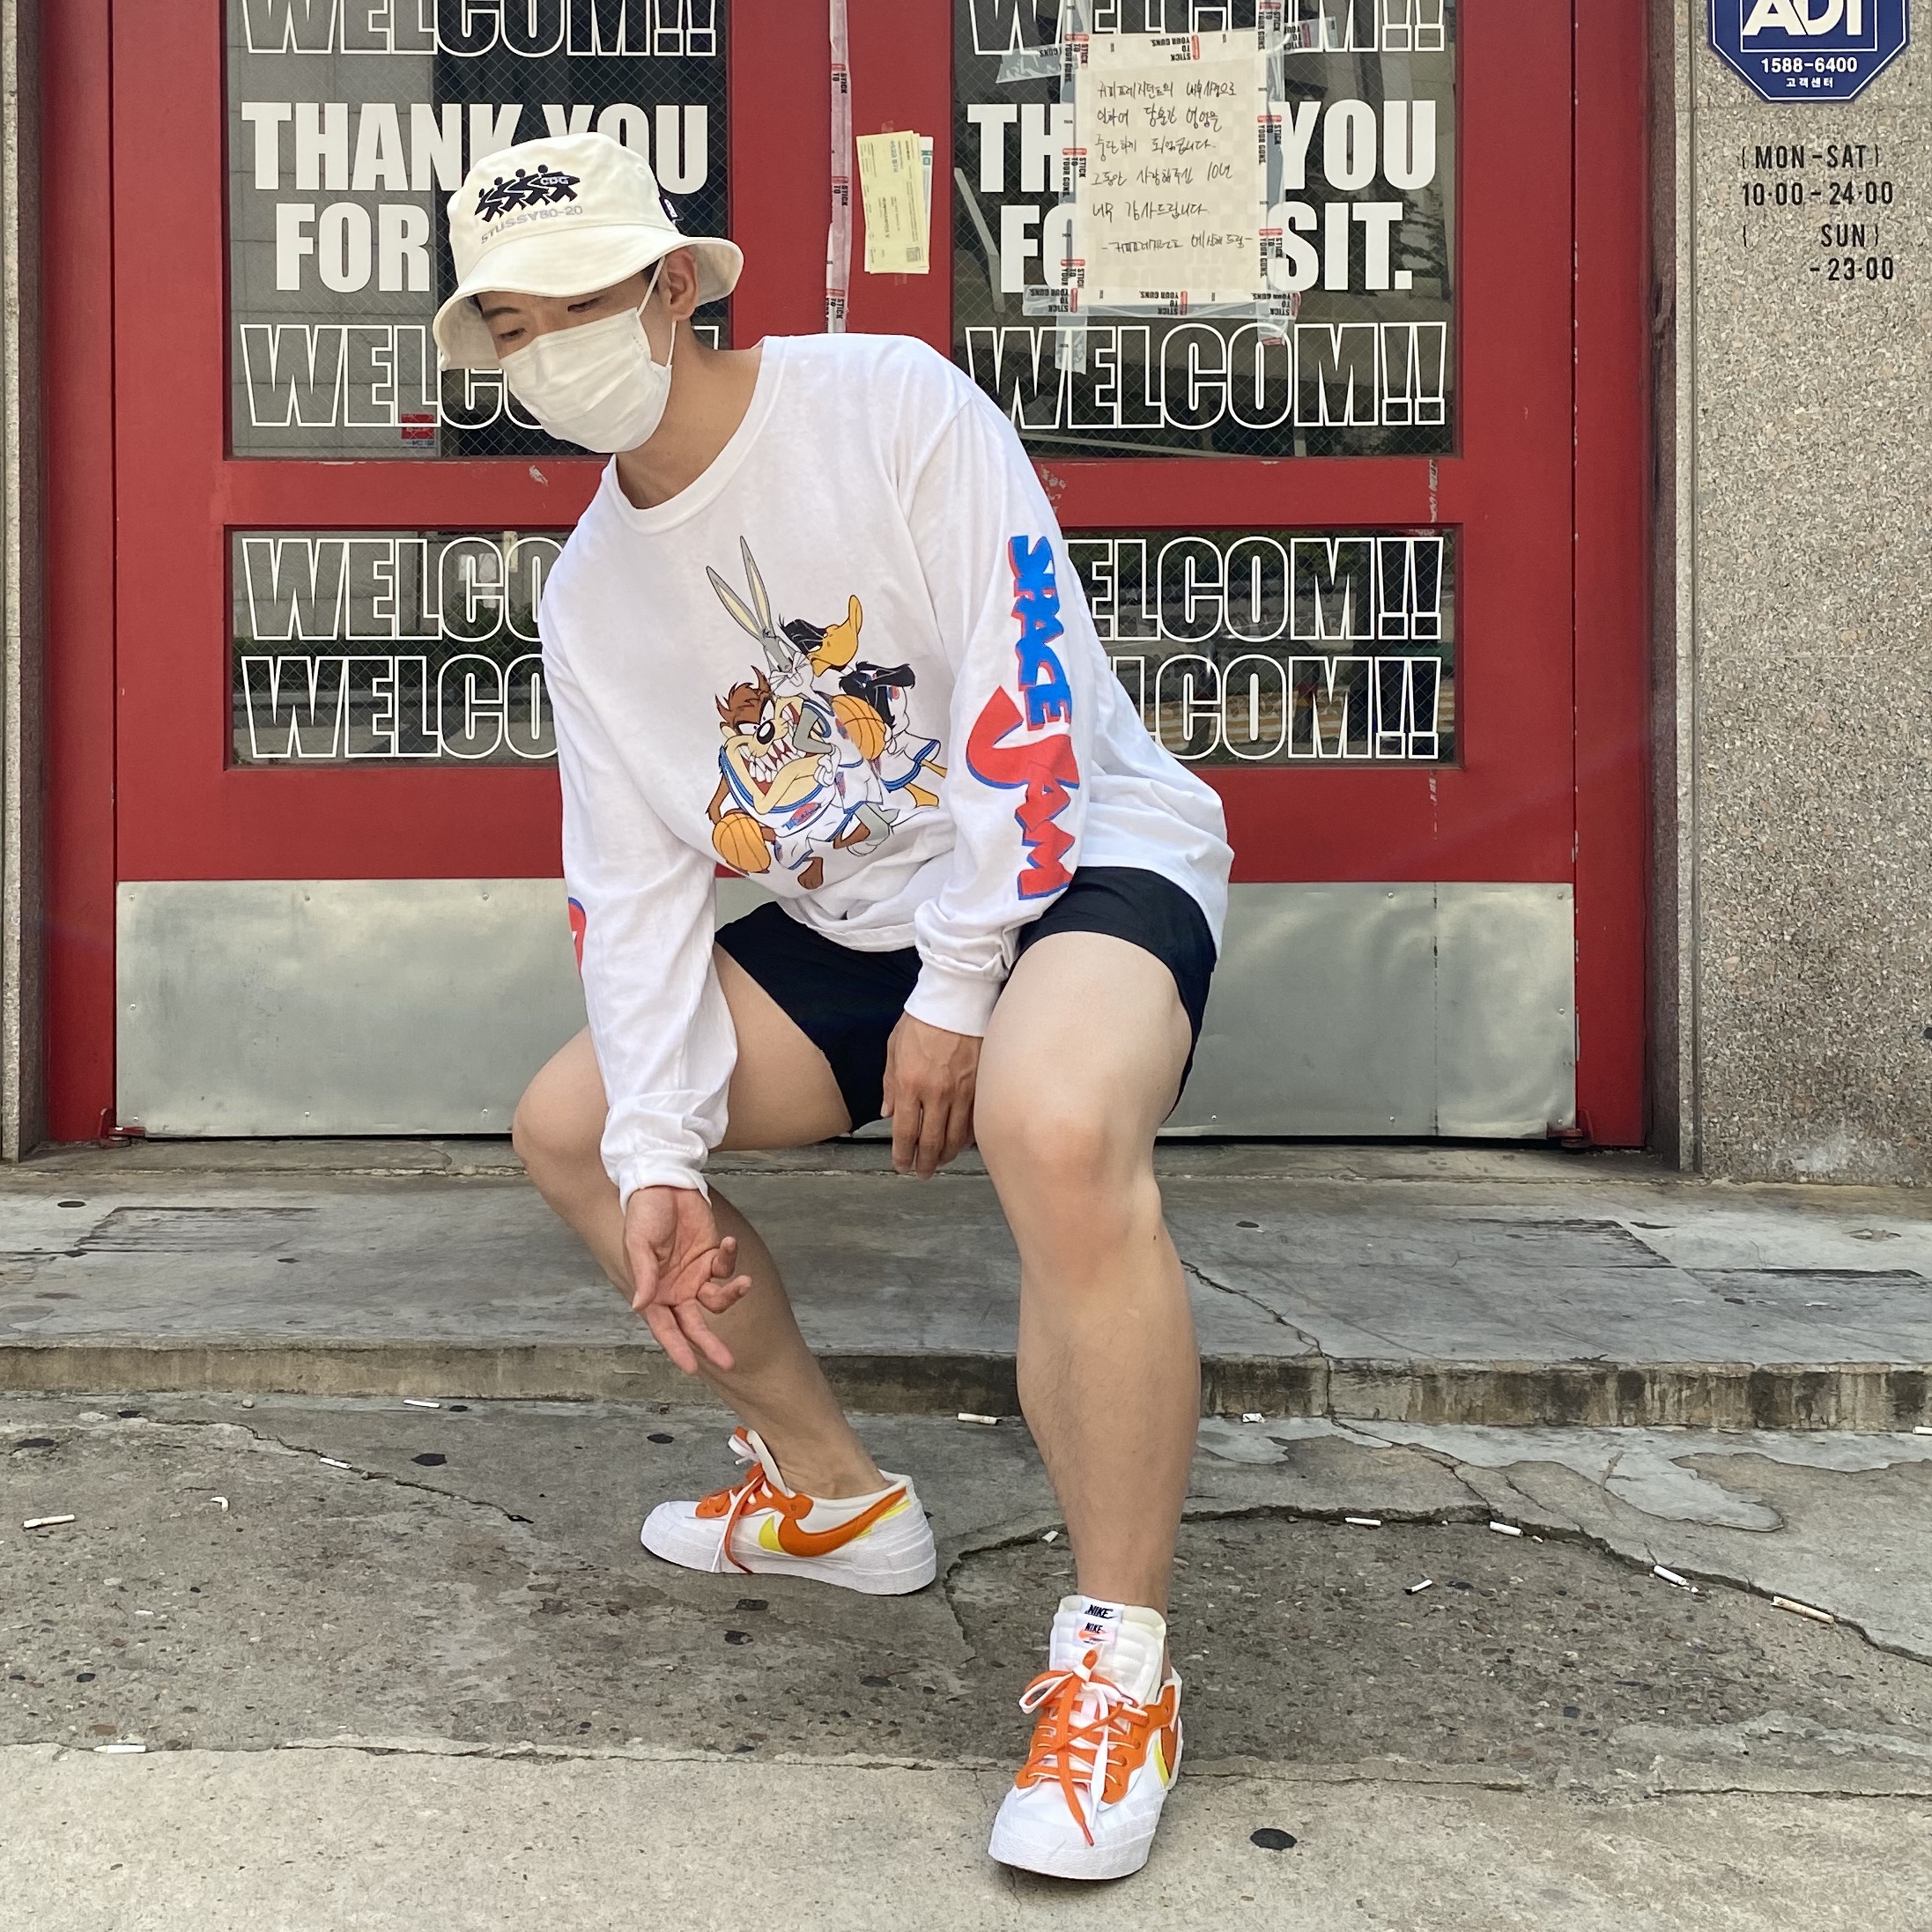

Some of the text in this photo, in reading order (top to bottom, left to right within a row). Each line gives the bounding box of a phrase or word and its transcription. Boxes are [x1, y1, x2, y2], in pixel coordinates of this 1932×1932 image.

[1760, 57, 1858, 74] 1588-6400
[1786, 78, 1834, 89] 고객센터
[241, 101, 523, 192] THANK
[539, 176, 571, 186] CDG
[1268, 100, 1437, 191] YOU
[276, 203, 431, 292] FOR
[1266, 201, 1413, 292] SIT.
[966, 322, 1447, 430] WELCOM!!
[1007, 534, 1073, 732] SPACE
[1063, 536, 1444, 643] ELCOM!!
[966, 685, 1080, 901] JAM
[1084, 1603, 1115, 1619] NIKE
[1084, 1622, 1105, 1634] NIKE
